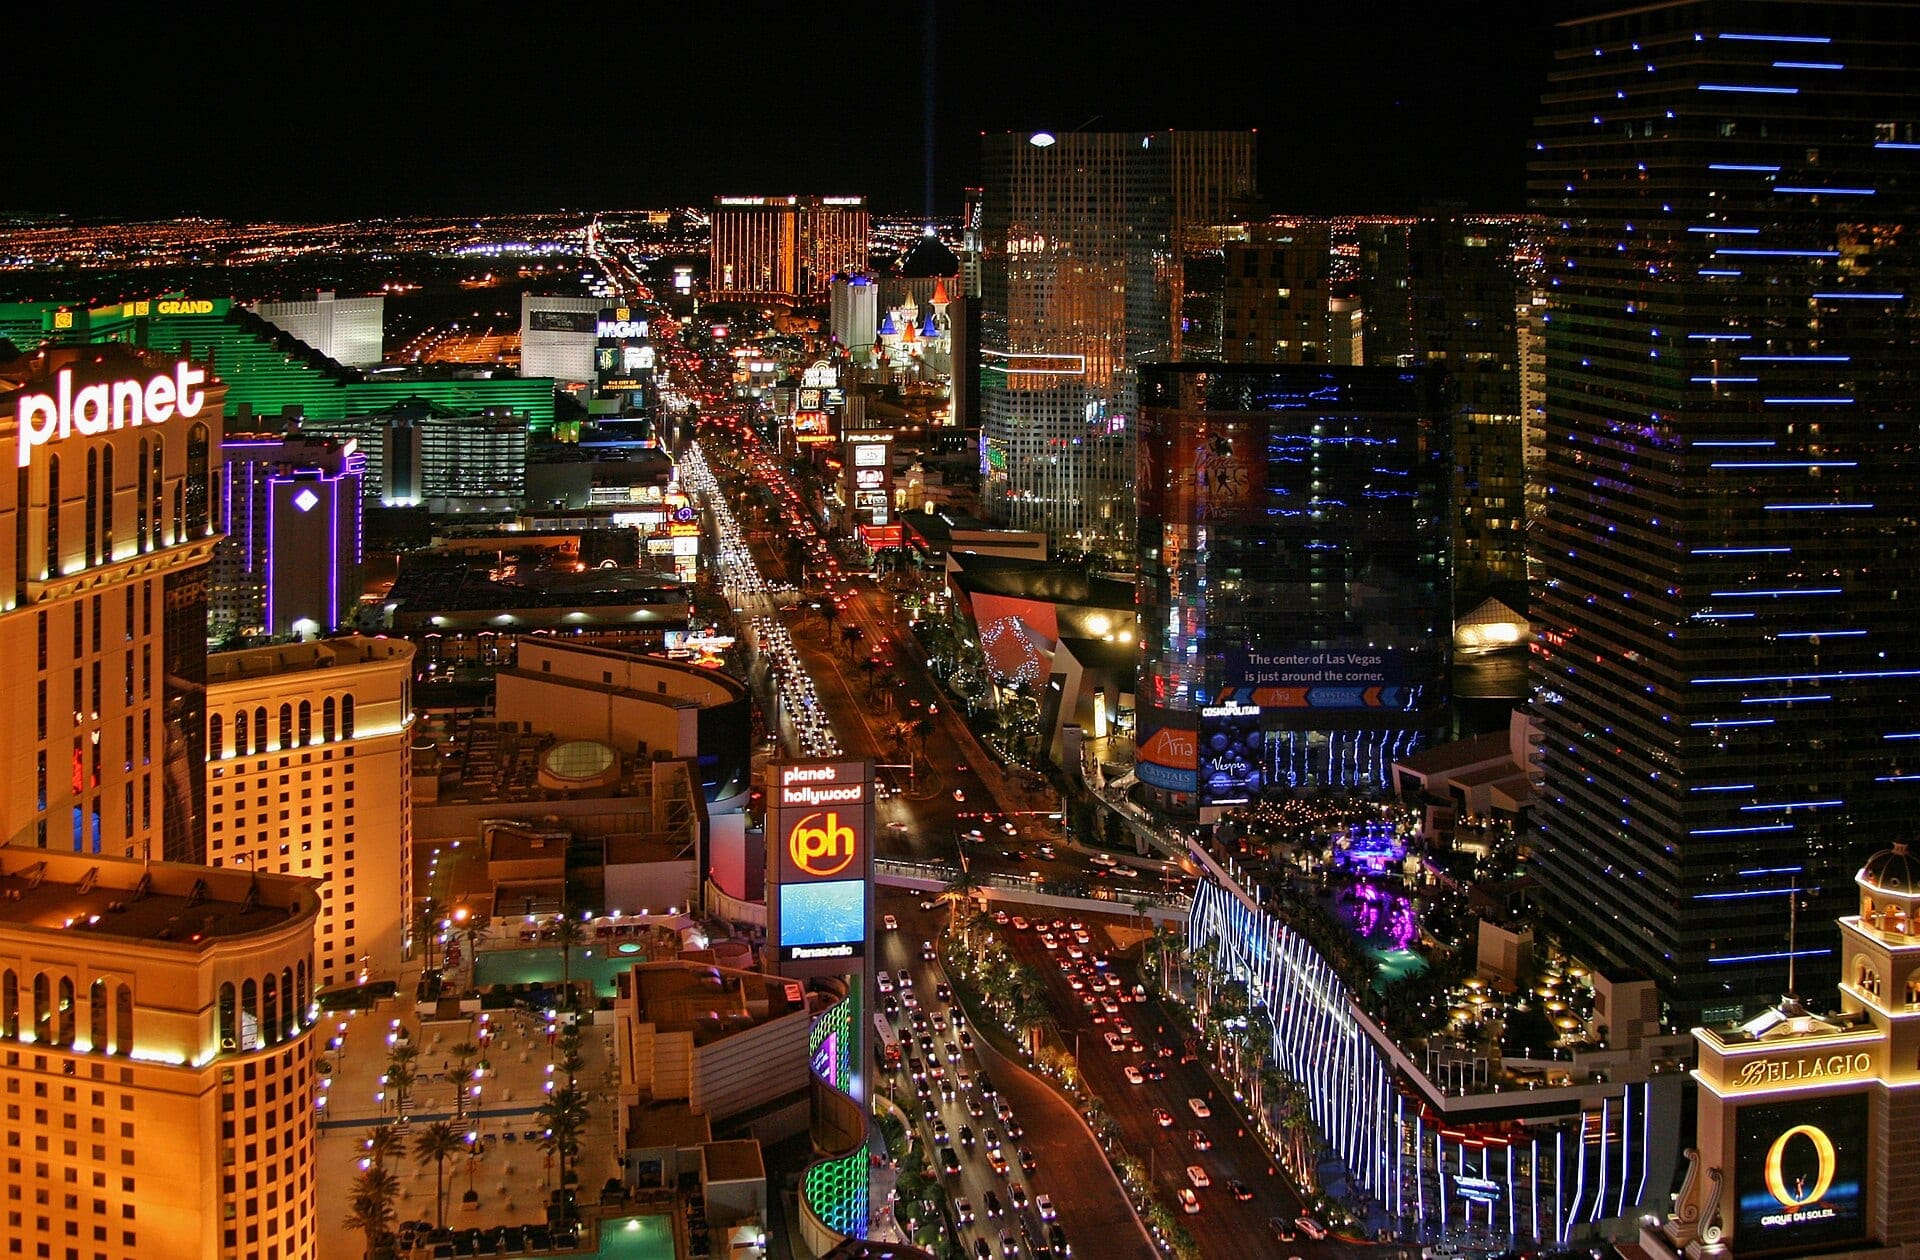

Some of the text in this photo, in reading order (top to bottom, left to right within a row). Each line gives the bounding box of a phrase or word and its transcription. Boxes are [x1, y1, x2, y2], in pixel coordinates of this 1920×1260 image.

[158, 300, 213, 315] GRAND
[597, 321, 649, 338] MGM
[18, 361, 205, 468] planet
[1248, 653, 1382, 667] The center of Las Vegas
[1244, 670, 1385, 683] is just around the corner.
[1202, 706, 1260, 717] COSMOPOLITAN
[1157, 731, 1193, 756] Aria
[783, 766, 835, 785] planet
[1144, 764, 1191, 783] CRYSTALS
[783, 786, 861, 805] hollywood
[798, 813, 855, 868] ph
[791, 945, 853, 959] Panasonic
[1732, 1053, 1872, 1088] BELLAGIO
[1764, 1124, 1837, 1206] O
[1760, 1208, 1837, 1226] CIRQUE DU SOLEIL
